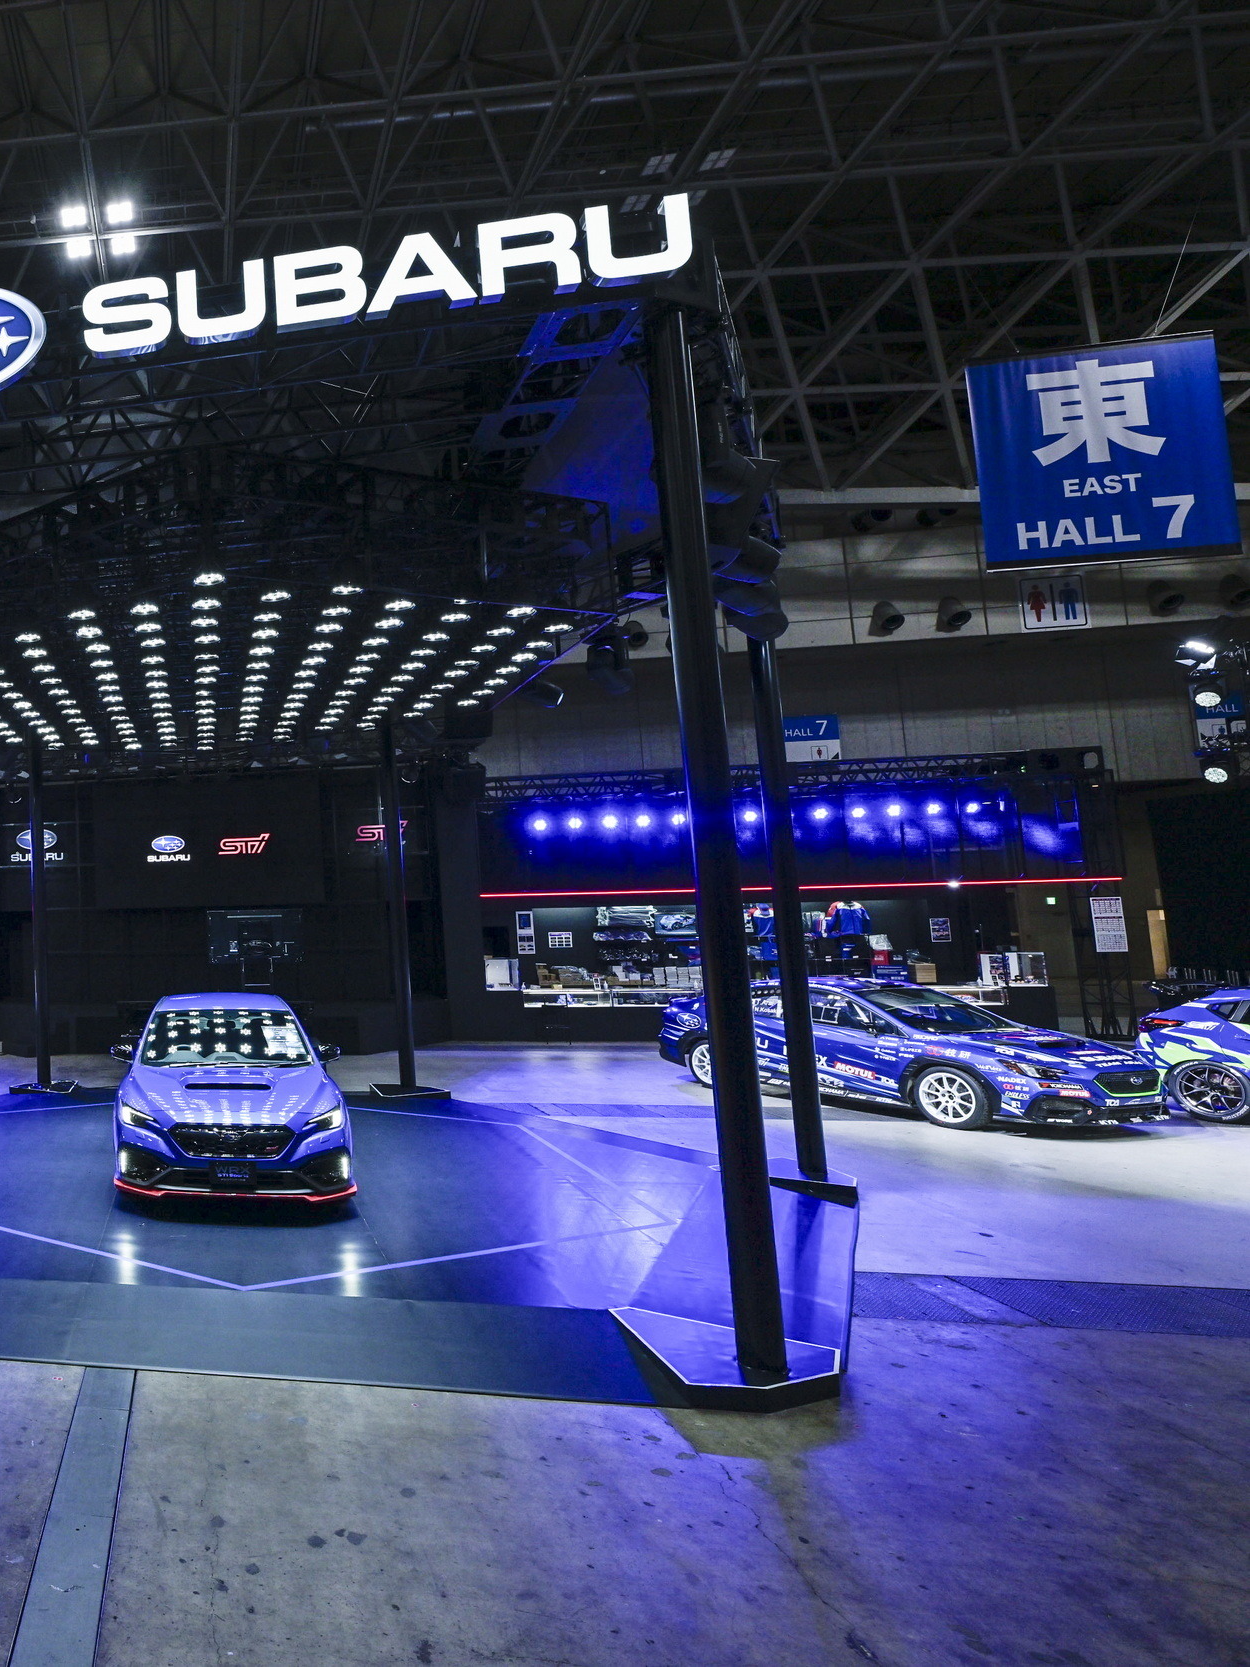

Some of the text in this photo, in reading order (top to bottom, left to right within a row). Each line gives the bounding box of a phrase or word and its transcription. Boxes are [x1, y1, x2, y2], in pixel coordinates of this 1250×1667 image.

[83, 193, 690, 355] SUBARU
[1025, 359, 1167, 467] 東
[1063, 473, 1142, 498] EAST
[1016, 494, 1195, 550] HALL 7
[784, 720, 828, 737] HALL 7
[10, 852, 64, 862] SUBRU
[146, 854, 191, 863] SUBARU
[835, 1062, 875, 1079] MOTUL
